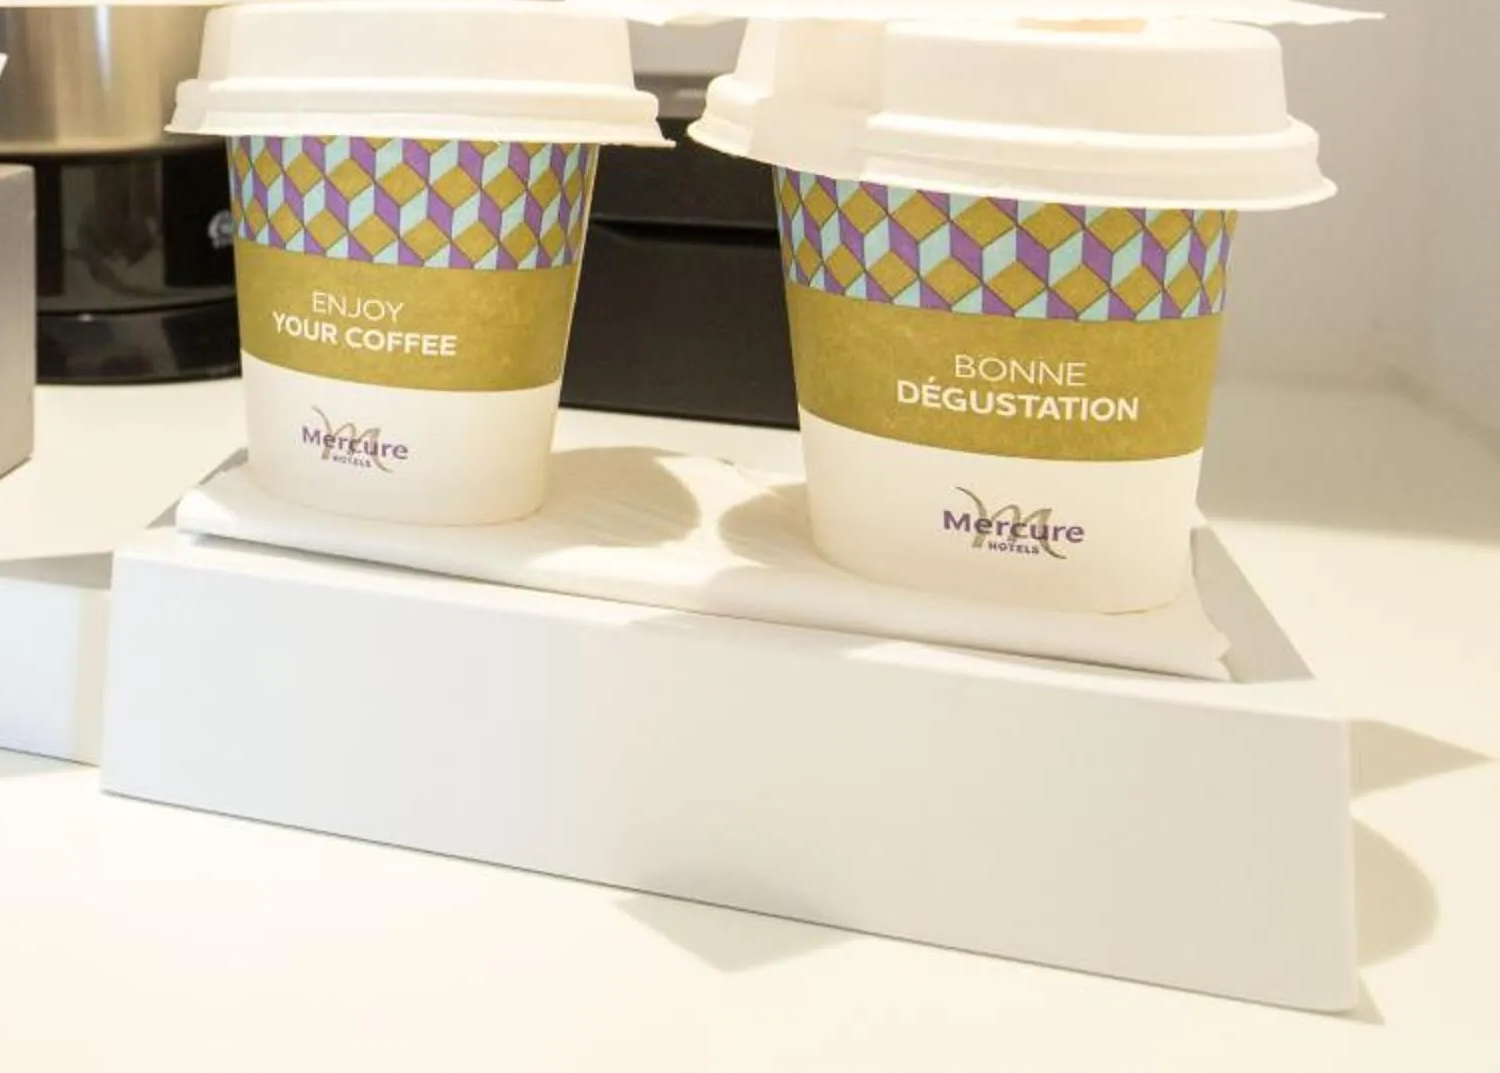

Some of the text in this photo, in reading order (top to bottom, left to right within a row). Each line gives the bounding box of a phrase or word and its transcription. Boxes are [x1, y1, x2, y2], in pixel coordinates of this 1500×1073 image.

[311, 290, 404, 323] ENJOY
[272, 311, 458, 357] YOUR COFFEE
[954, 354, 1087, 387] BONNE
[897, 375, 1140, 422] DÉGUSTATION
[302, 425, 409, 460] Mercure
[943, 509, 1085, 544] Mercure
[988, 541, 1040, 555] HOTELS
